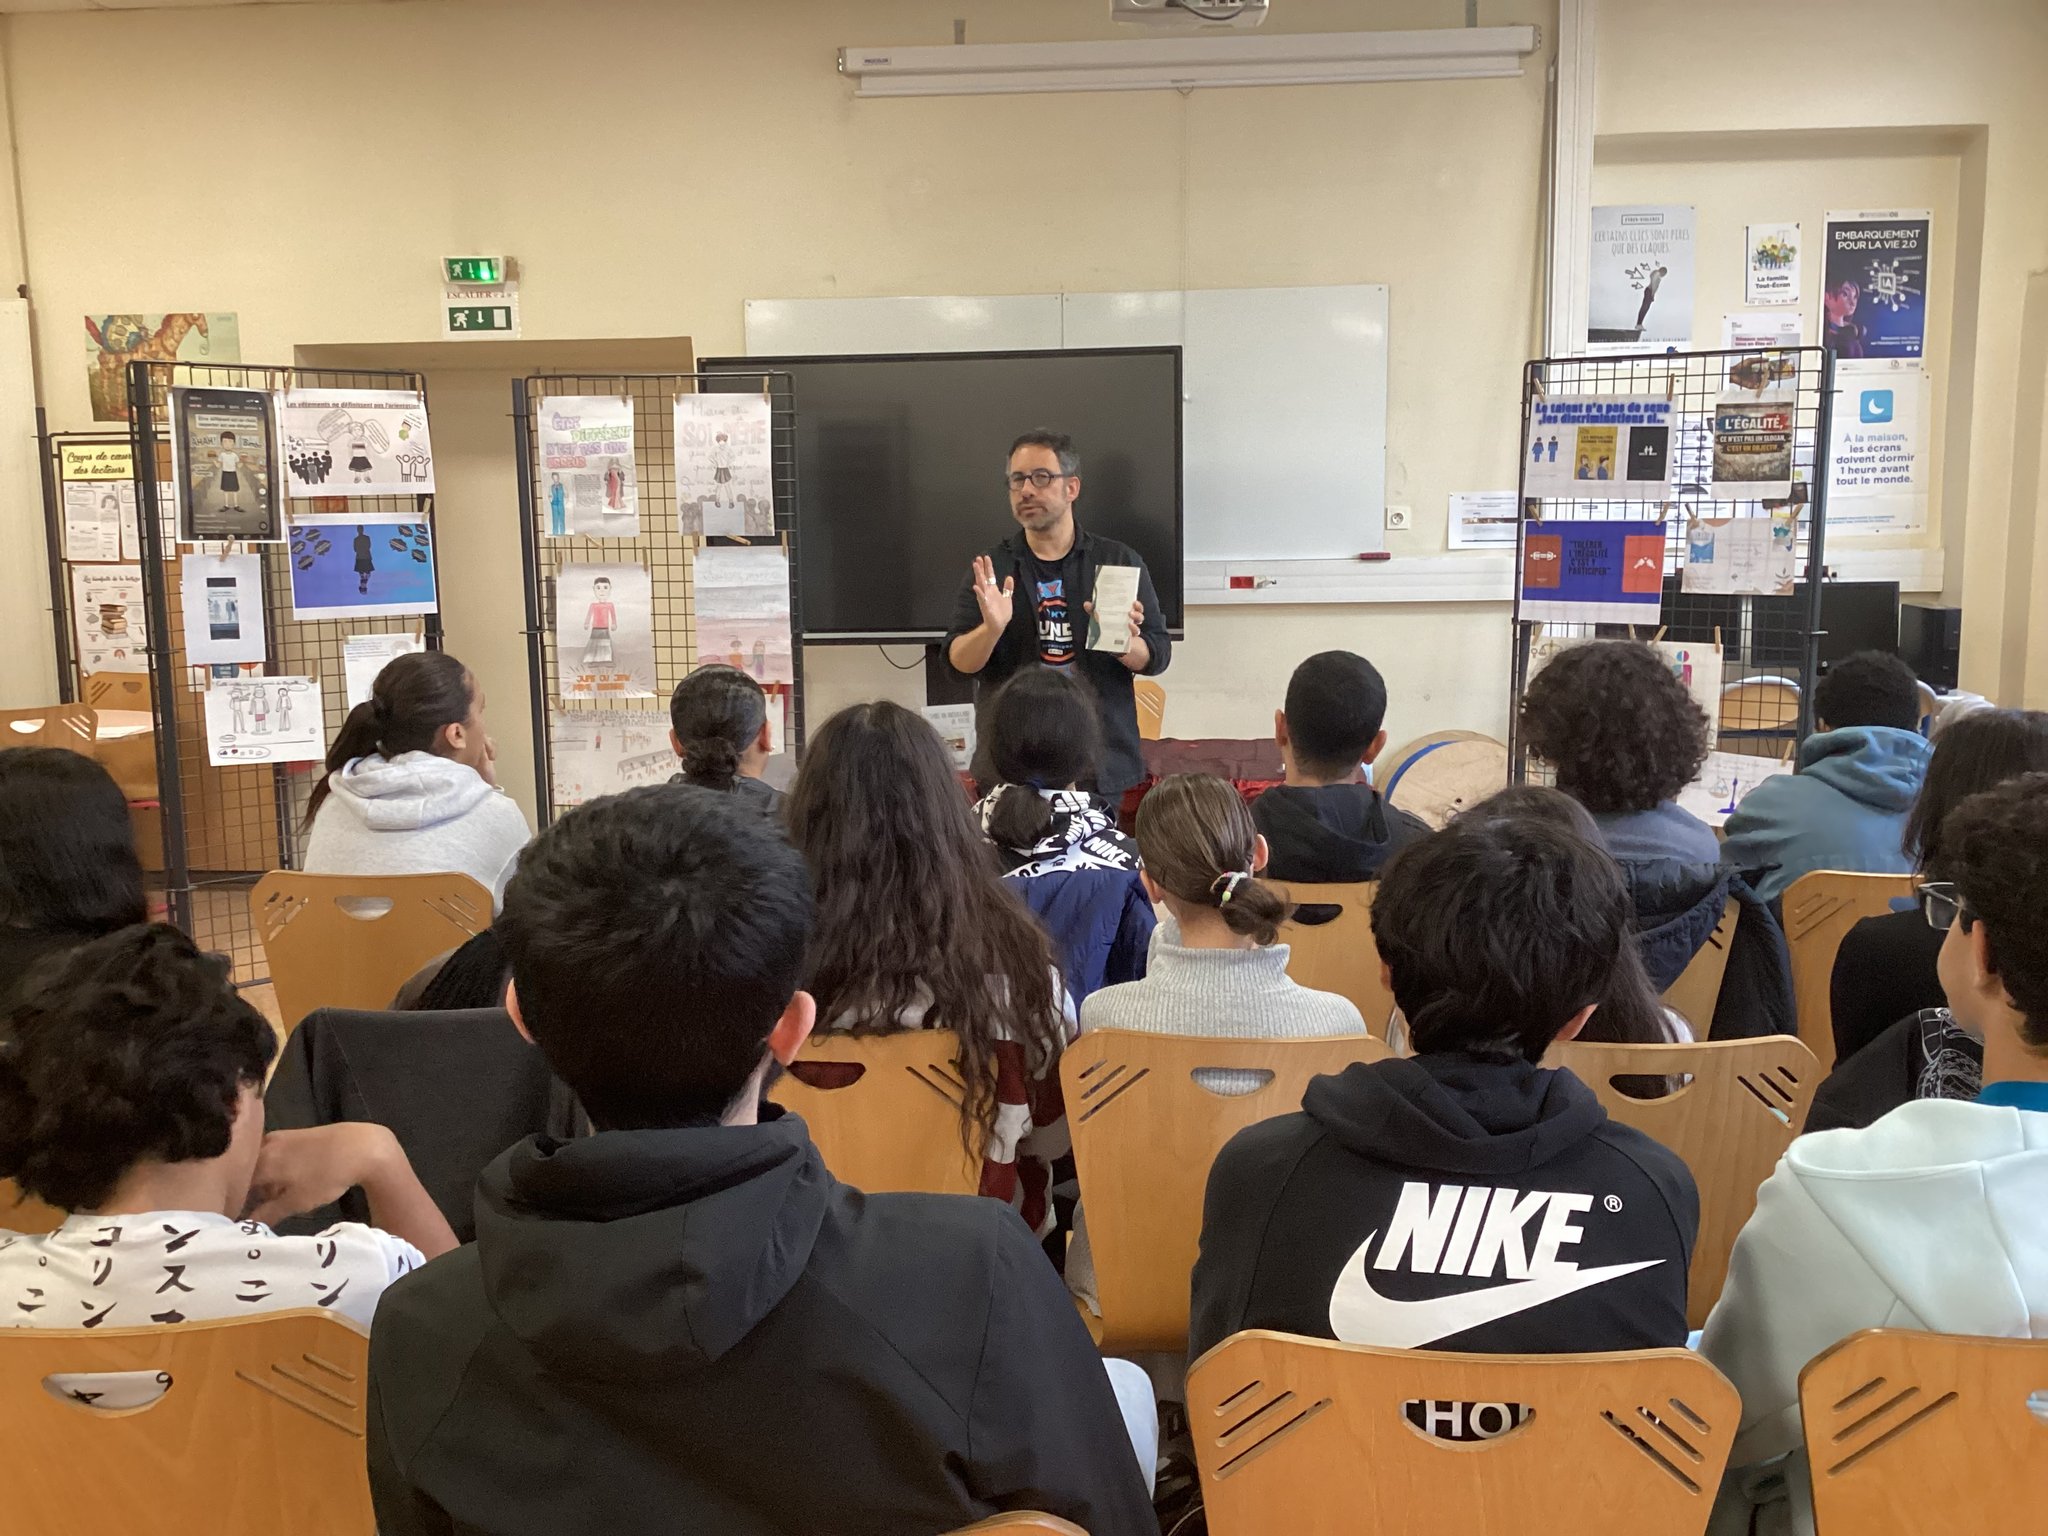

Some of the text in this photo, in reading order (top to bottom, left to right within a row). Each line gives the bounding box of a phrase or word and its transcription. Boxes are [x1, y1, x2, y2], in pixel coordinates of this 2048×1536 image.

[1594, 229, 1690, 242] CERTAINS CLICS SONT PIRES
[1835, 229, 1921, 240] EMBARQUEMENT
[1611, 242, 1625, 257] QUE
[1626, 242, 1639, 254] DES
[1838, 240, 1917, 250] POUR LA VIE 2.0
[1882, 278, 1892, 287] IA
[447, 290, 493, 299] ESCALIER
[341, 402, 373, 410] définissent
[1535, 402, 1671, 414] Le talent n'a pas de sexe
[1560, 413, 1645, 424] discriminations
[1725, 415, 1784, 430] L'ÉGALITÉ,
[1728, 435, 1743, 443] N'EST
[1843, 432, 1909, 443] À la maison,
[1743, 444, 1752, 452] UN
[1849, 444, 1902, 453] les écrans
[67, 452, 93, 464] Coups
[95, 451, 108, 461] de
[1836, 453, 1915, 464] doivent dormir
[73, 464, 126, 475] des lecteurs
[1840, 464, 1910, 475] 1 heure avant
[1836, 474, 1914, 486] tout le monde.
[1083, 836, 1132, 866] NIKE
[1373, 1181, 1594, 1280] NIKE
